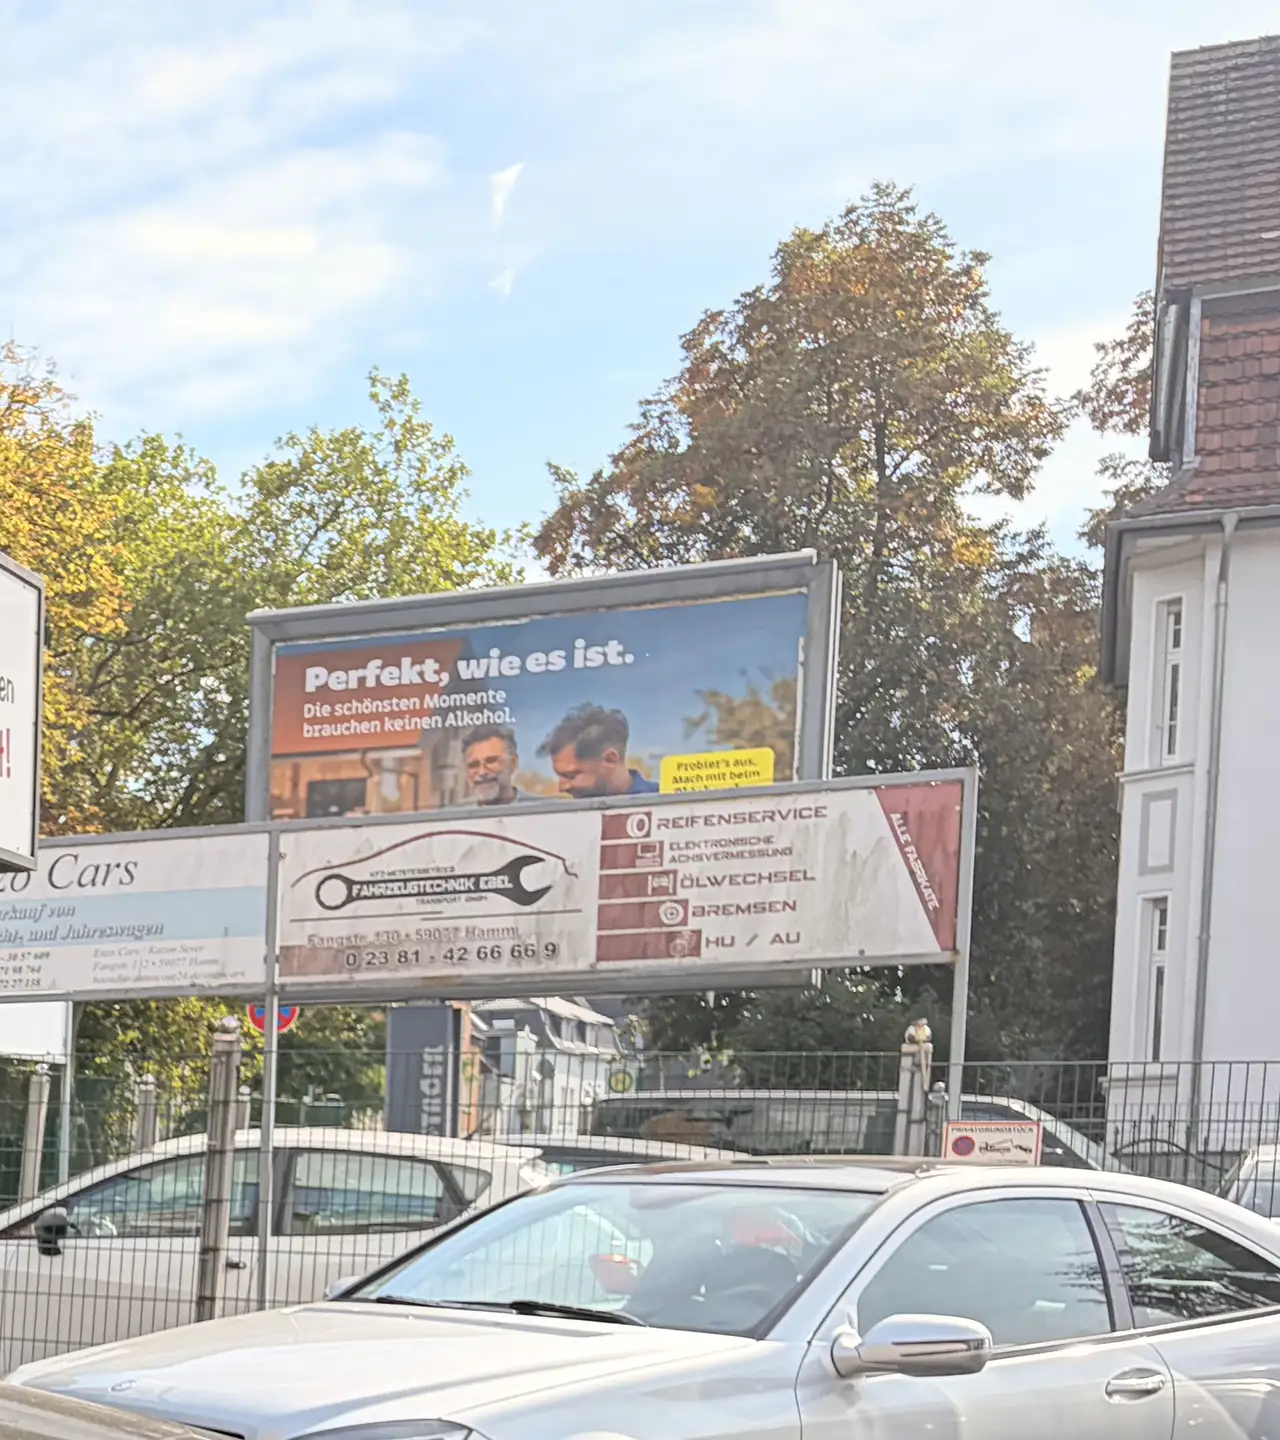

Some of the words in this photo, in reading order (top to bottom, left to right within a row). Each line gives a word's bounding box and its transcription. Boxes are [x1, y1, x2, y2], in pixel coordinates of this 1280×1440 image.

[304, 657, 450, 693] Perfekt,
[457, 647, 521, 681] wie
[525, 648, 566, 673] es
[573, 638, 635, 669] ist.
[303, 701, 333, 719] Die
[334, 692, 420, 717] schönsten
[423, 689, 507, 709] Momente
[303, 718, 383, 738] brauchen
[385, 712, 443, 732] keinen
[445, 707, 517, 728] Alkohol.
[672, 774, 704, 785] Mach
[706, 772, 727, 782] mit
[729, 769, 760, 780] beim
[656, 806, 828, 830] REIFENSERVICE
[668, 835, 775, 851] ELEKTRONISCHE
[668, 846, 793, 865] ACHSVERMESSUNG
[890, 812, 912, 845] ALLE
[901, 845, 940, 911] FABRIKATE
[47, 852, 138, 890] Cars
[680, 869, 816, 890] ÖLWECHSEL
[352, 879, 476, 899] FAHRZEUGTECHNIK
[479, 875, 514, 890] EBEL
[48, 904, 76, 918] von
[691, 900, 797, 918] BREMSEN
[27, 925, 59, 942] und
[60, 922, 165, 942] Jahreswagen
[705, 935, 735, 949] HU
[745, 934, 759, 947] /
[769, 932, 801, 946] AU
[346, 952, 357, 968] 0
[366, 950, 390, 966] 23
[397, 949, 421, 964] 81
[443, 946, 469, 962] 42
[476, 944, 501, 960] 66
[510, 943, 535, 959] 66
[544, 941, 557, 958] 9
